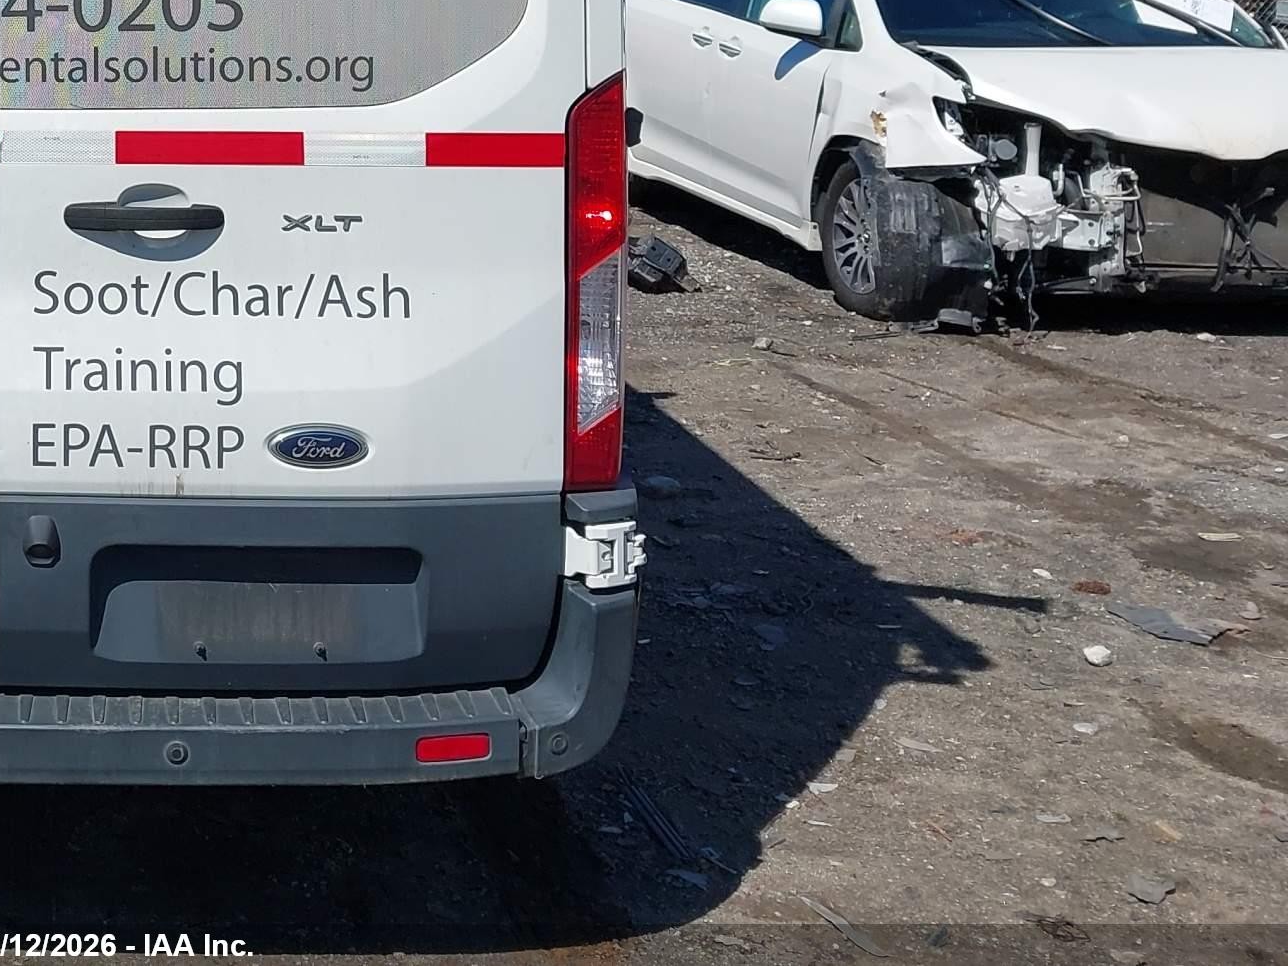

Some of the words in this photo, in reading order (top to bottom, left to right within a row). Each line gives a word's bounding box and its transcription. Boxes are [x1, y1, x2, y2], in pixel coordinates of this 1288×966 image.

[281, 215, 363, 233] XLT
[33, 270, 412, 321] Soot/Char/Ash
[33, 346, 245, 407] Training
[32, 423, 247, 470] EPA-RRP
[292, 436, 346, 458] Ford
